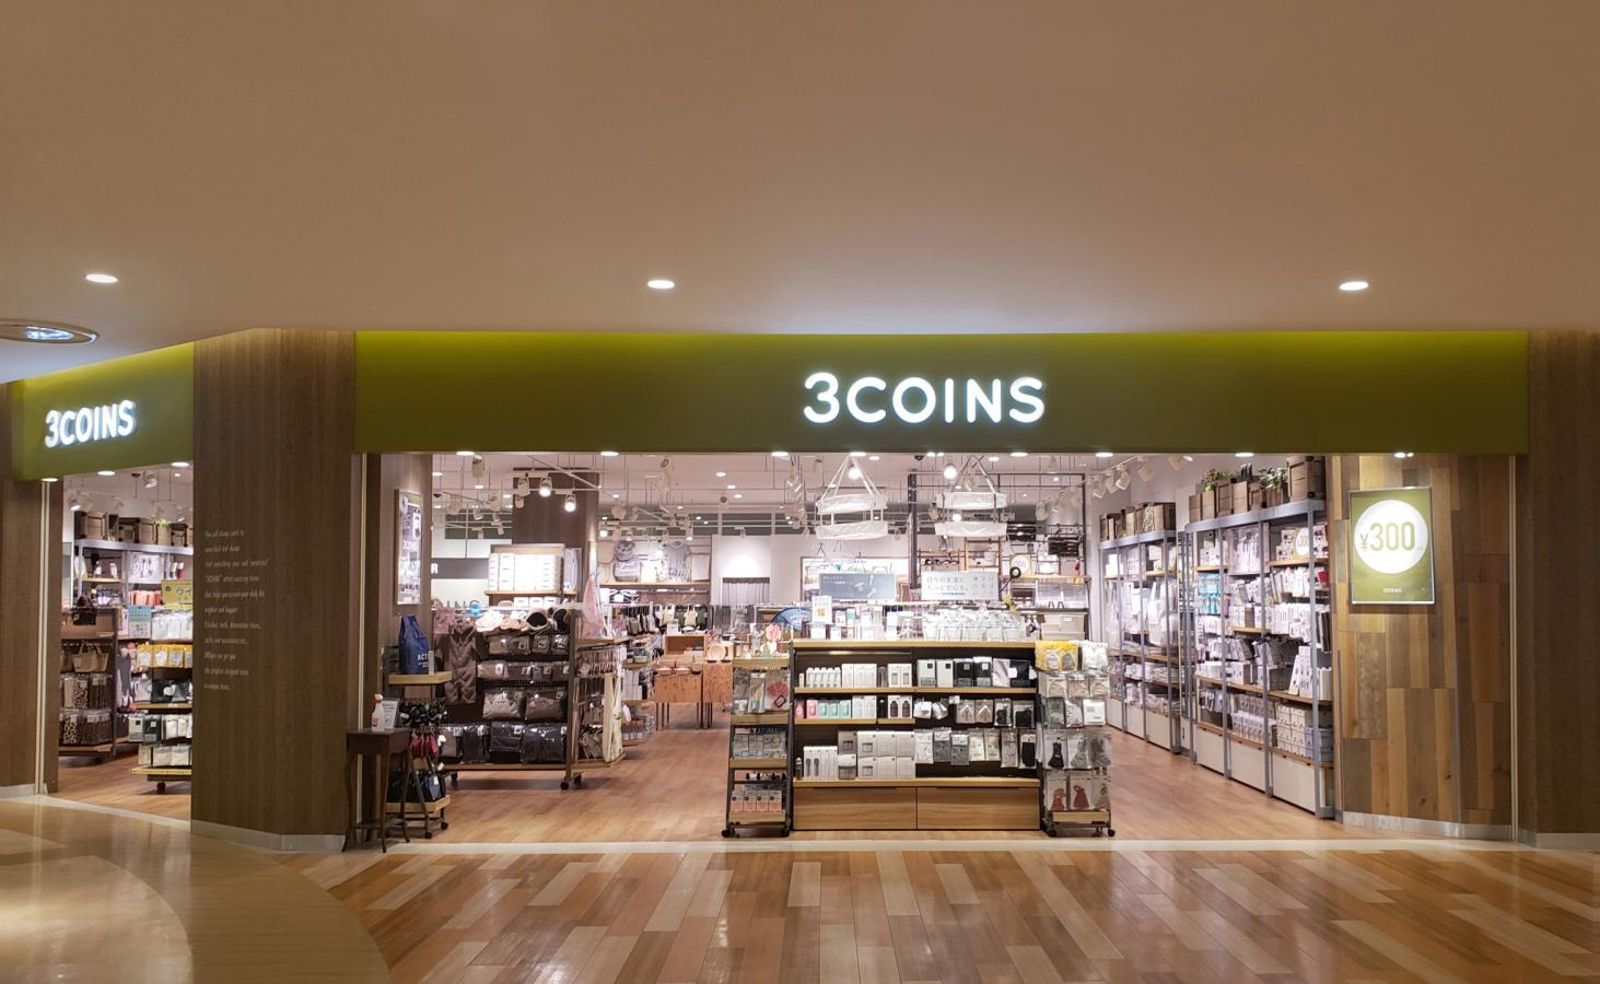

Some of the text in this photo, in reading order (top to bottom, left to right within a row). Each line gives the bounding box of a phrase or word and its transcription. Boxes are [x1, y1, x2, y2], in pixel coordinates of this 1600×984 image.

[803, 372, 1045, 423] 3COINS
[44, 400, 136, 448] 3COINS
[1360, 522, 1415, 551] ¥300
